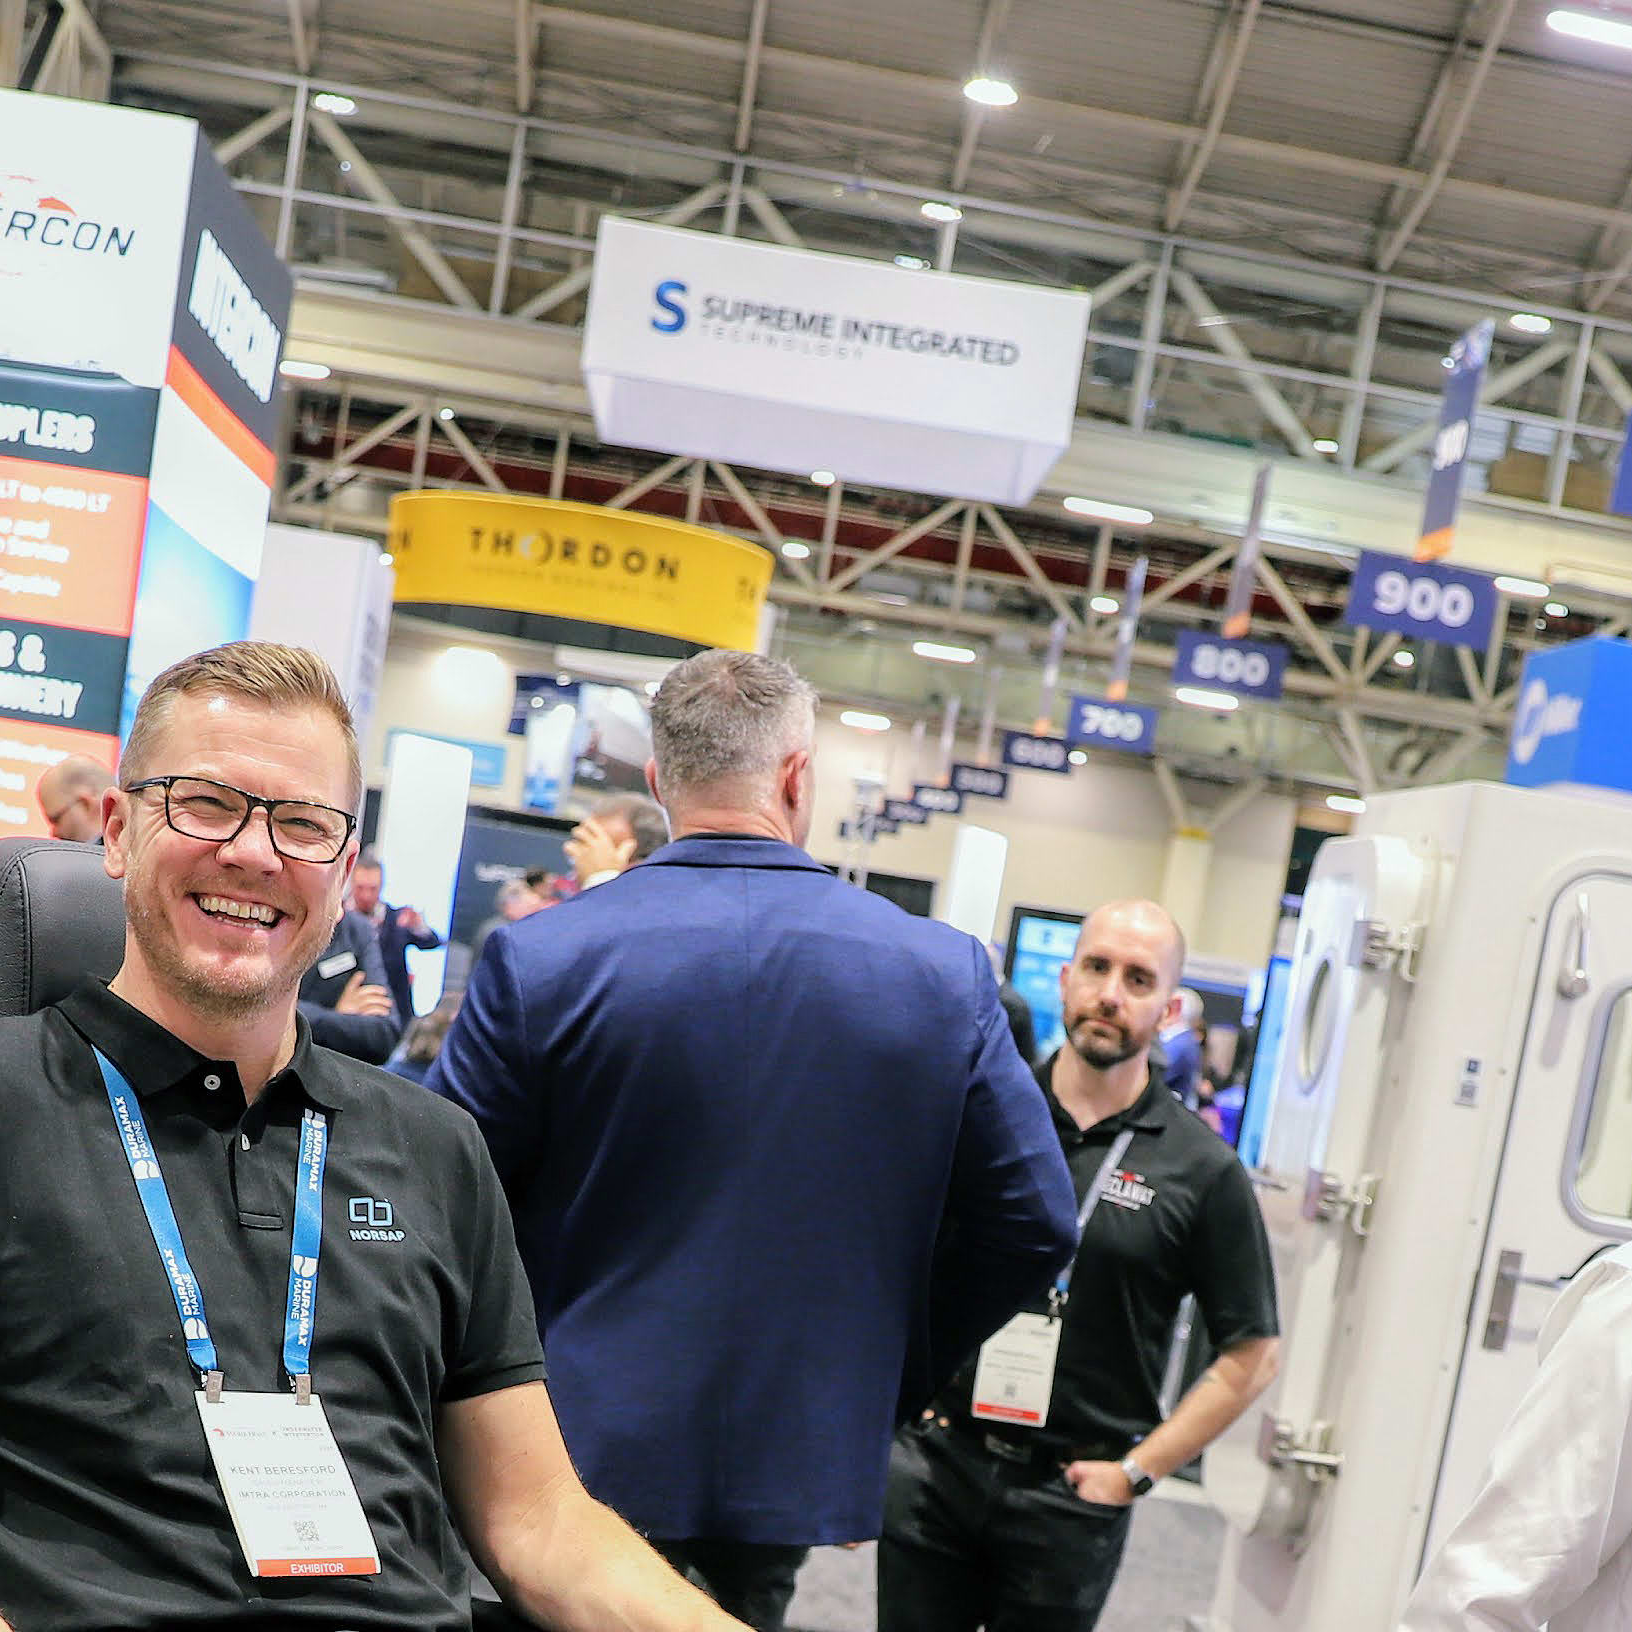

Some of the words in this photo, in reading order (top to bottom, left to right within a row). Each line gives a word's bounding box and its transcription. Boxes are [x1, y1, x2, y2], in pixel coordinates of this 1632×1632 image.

[702, 296, 835, 339] SUPREME
[841, 318, 1020, 366] INTEGRATED
[470, 527, 679, 579] THORDON
[1373, 570, 1475, 628] 900
[17, 633, 46, 673] &
[1191, 643, 1268, 687] 800
[114, 1095, 142, 1159] DURAMAX
[133, 1119, 151, 1158] MARINE
[303, 1127, 314, 1164] MARINE
[308, 1129, 324, 1192] DURAMAX
[349, 1229, 406, 1242] NORSAP
[164, 1248, 192, 1316] DURAMAX
[183, 1272, 200, 1316] MARINE
[291, 1277, 303, 1320] MARINE
[298, 1279, 312, 1347] DURAMAX
[230, 1466, 260, 1475] KENT
[265, 1465, 336, 1475] BERESFORD
[238, 1490, 270, 1499] IMTRA
[272, 1489, 346, 1499] CORPORATION
[290, 1562, 344, 1575] EXHIBITOR
